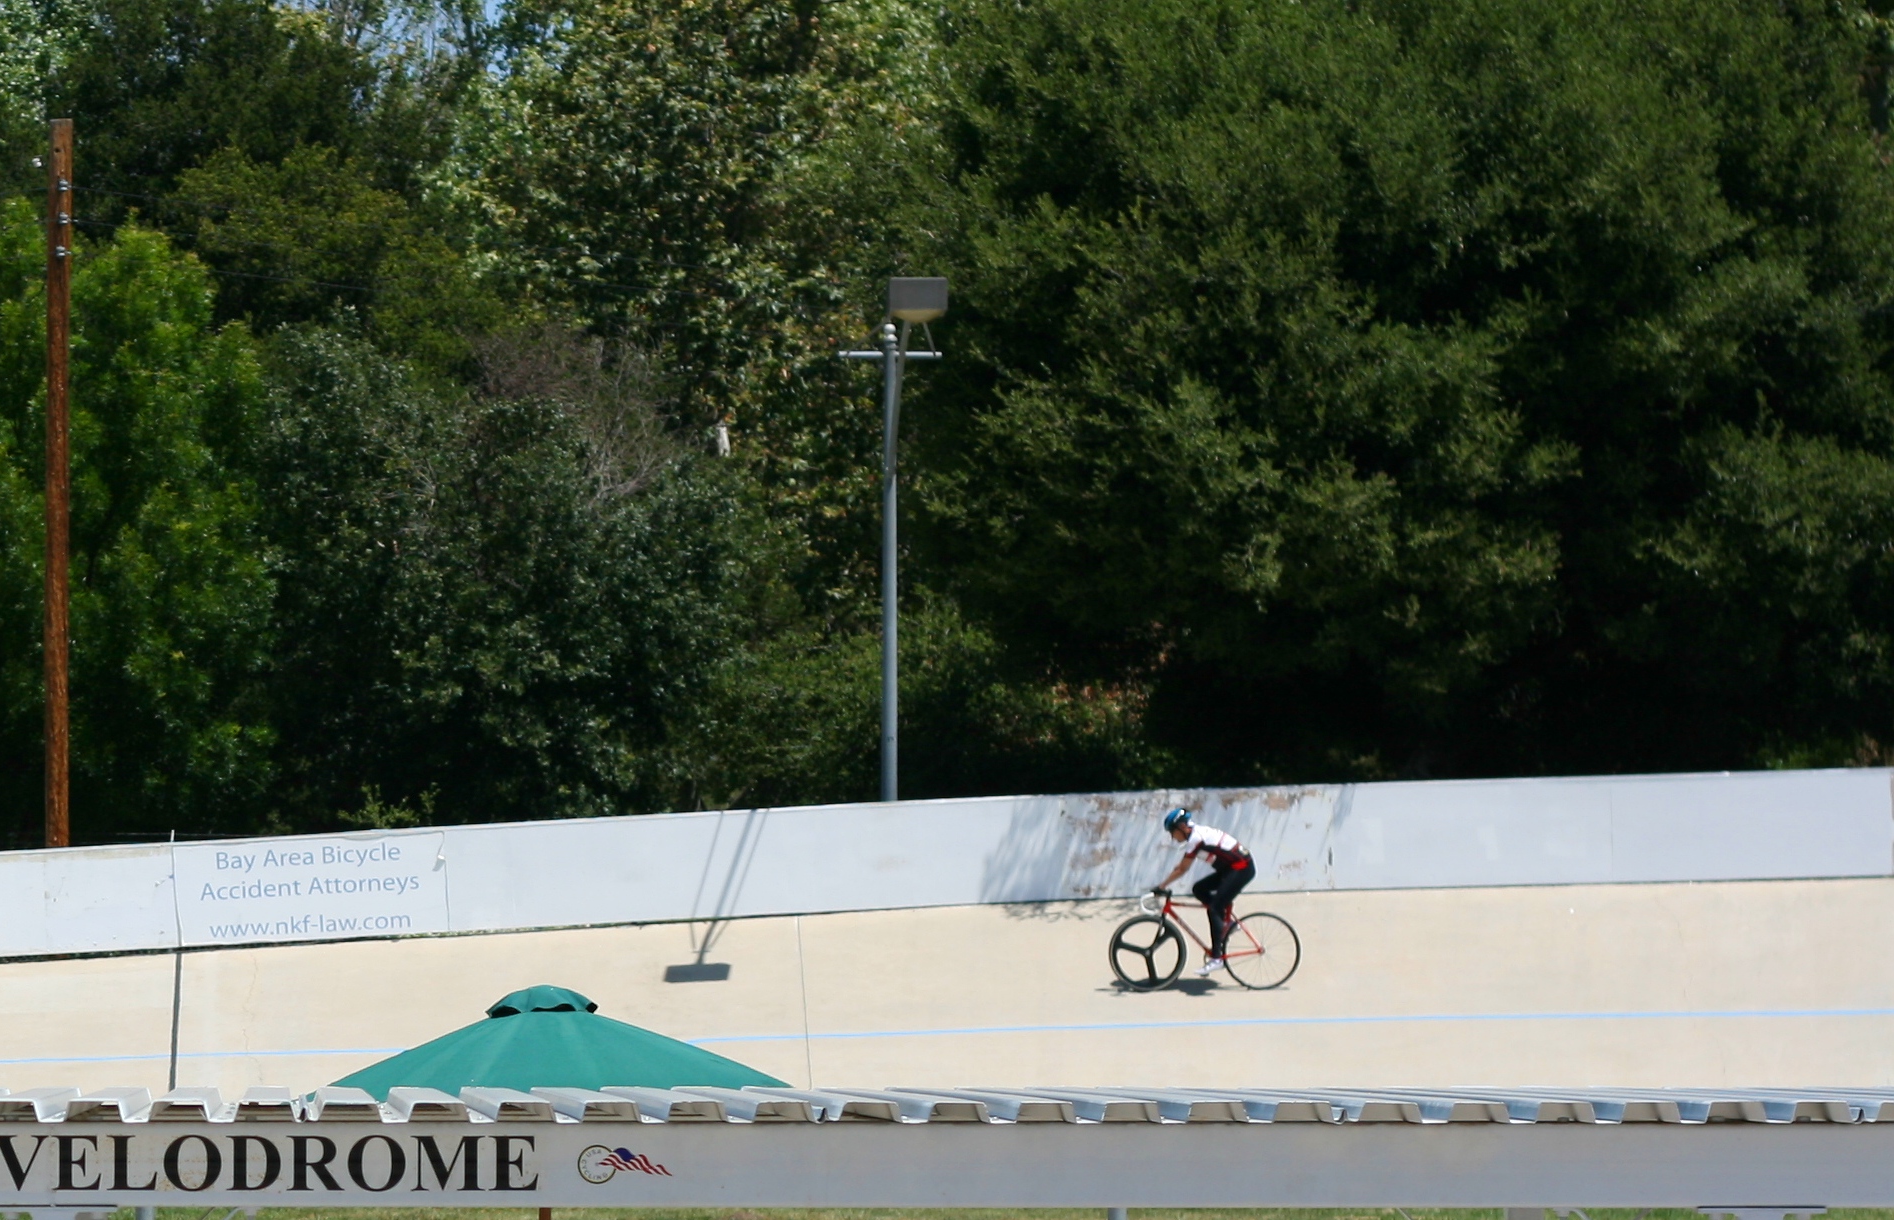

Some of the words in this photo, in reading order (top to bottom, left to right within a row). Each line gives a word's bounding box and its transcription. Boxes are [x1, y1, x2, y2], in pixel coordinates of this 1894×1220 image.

[215, 851, 256, 873] Bay
[263, 849, 315, 867] Area
[321, 842, 401, 867] Bicycle
[200, 879, 301, 901] Accident
[308, 875, 420, 895] Attorneys
[209, 914, 412, 938] www.nkf-law.com
